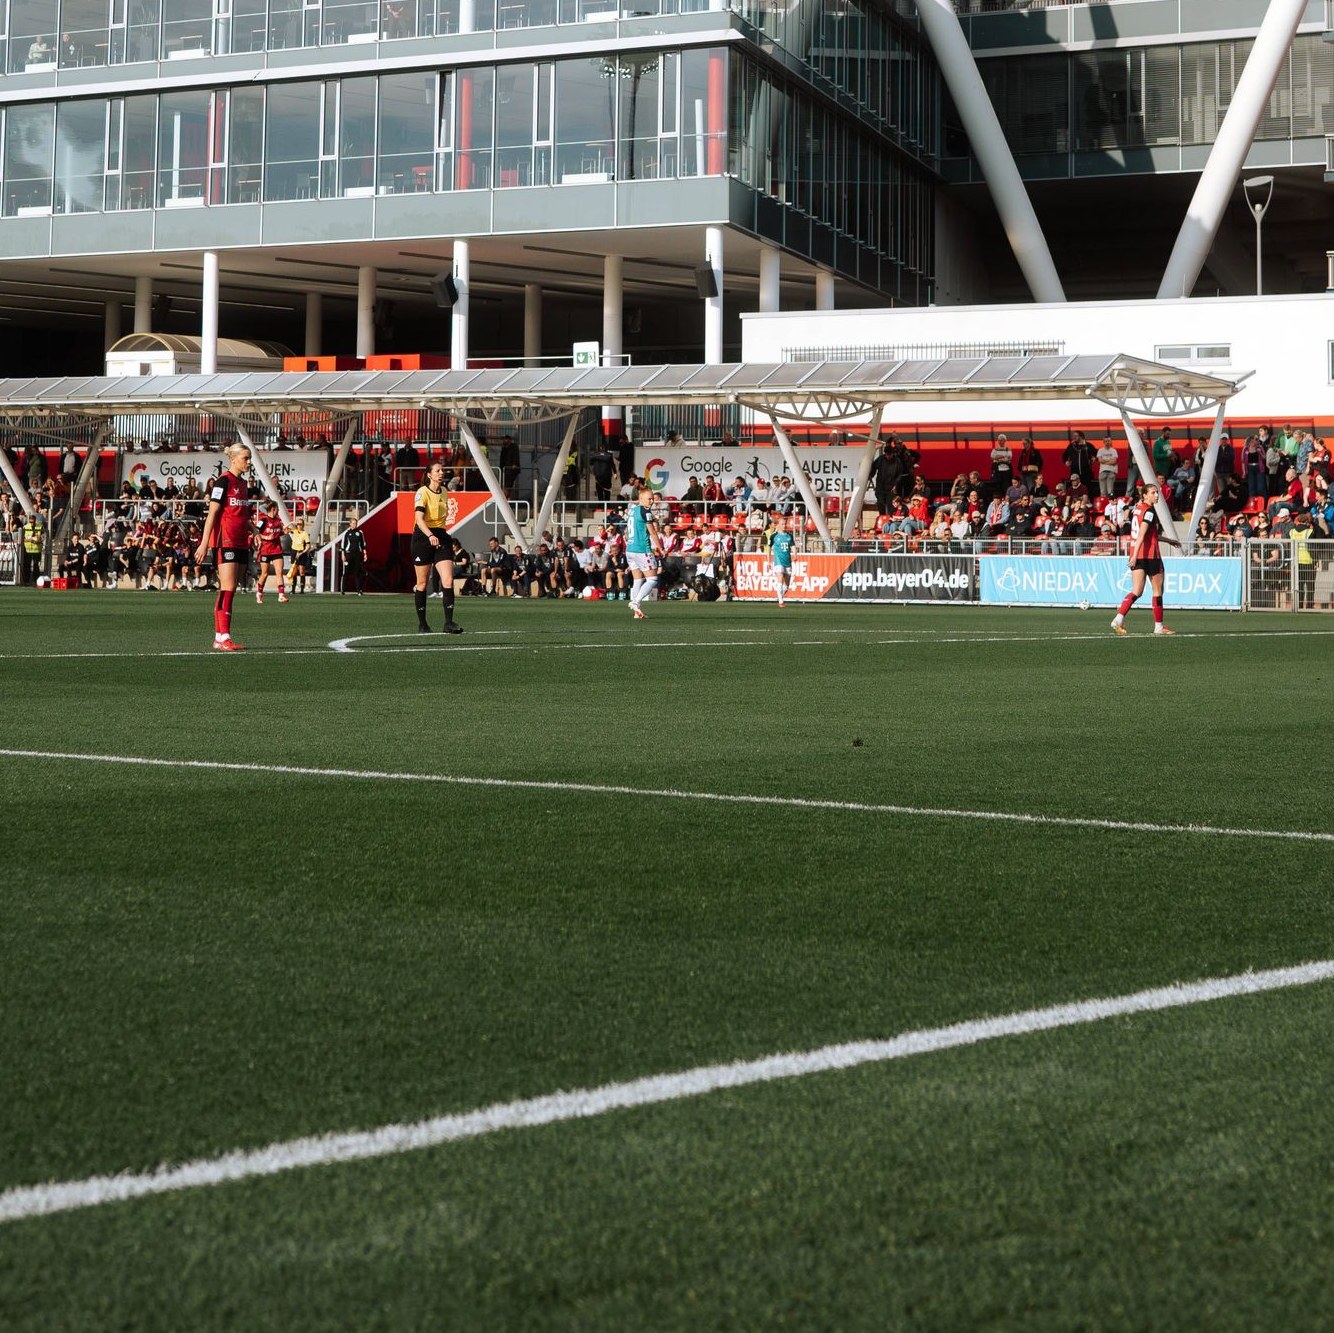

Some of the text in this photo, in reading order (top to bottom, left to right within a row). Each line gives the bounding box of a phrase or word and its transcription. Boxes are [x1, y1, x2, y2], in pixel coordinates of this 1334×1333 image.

[160, 460, 202, 480] Google
[680, 456, 733, 476] Google
[783, 460, 848, 474] FAUEN-
[736, 561, 762, 576] HOL
[736, 576, 829, 592] BAYER4-APP
[841, 568, 969, 592] app.bayer04.de
[1022, 572, 1222, 593] NIEDAX EDAX
